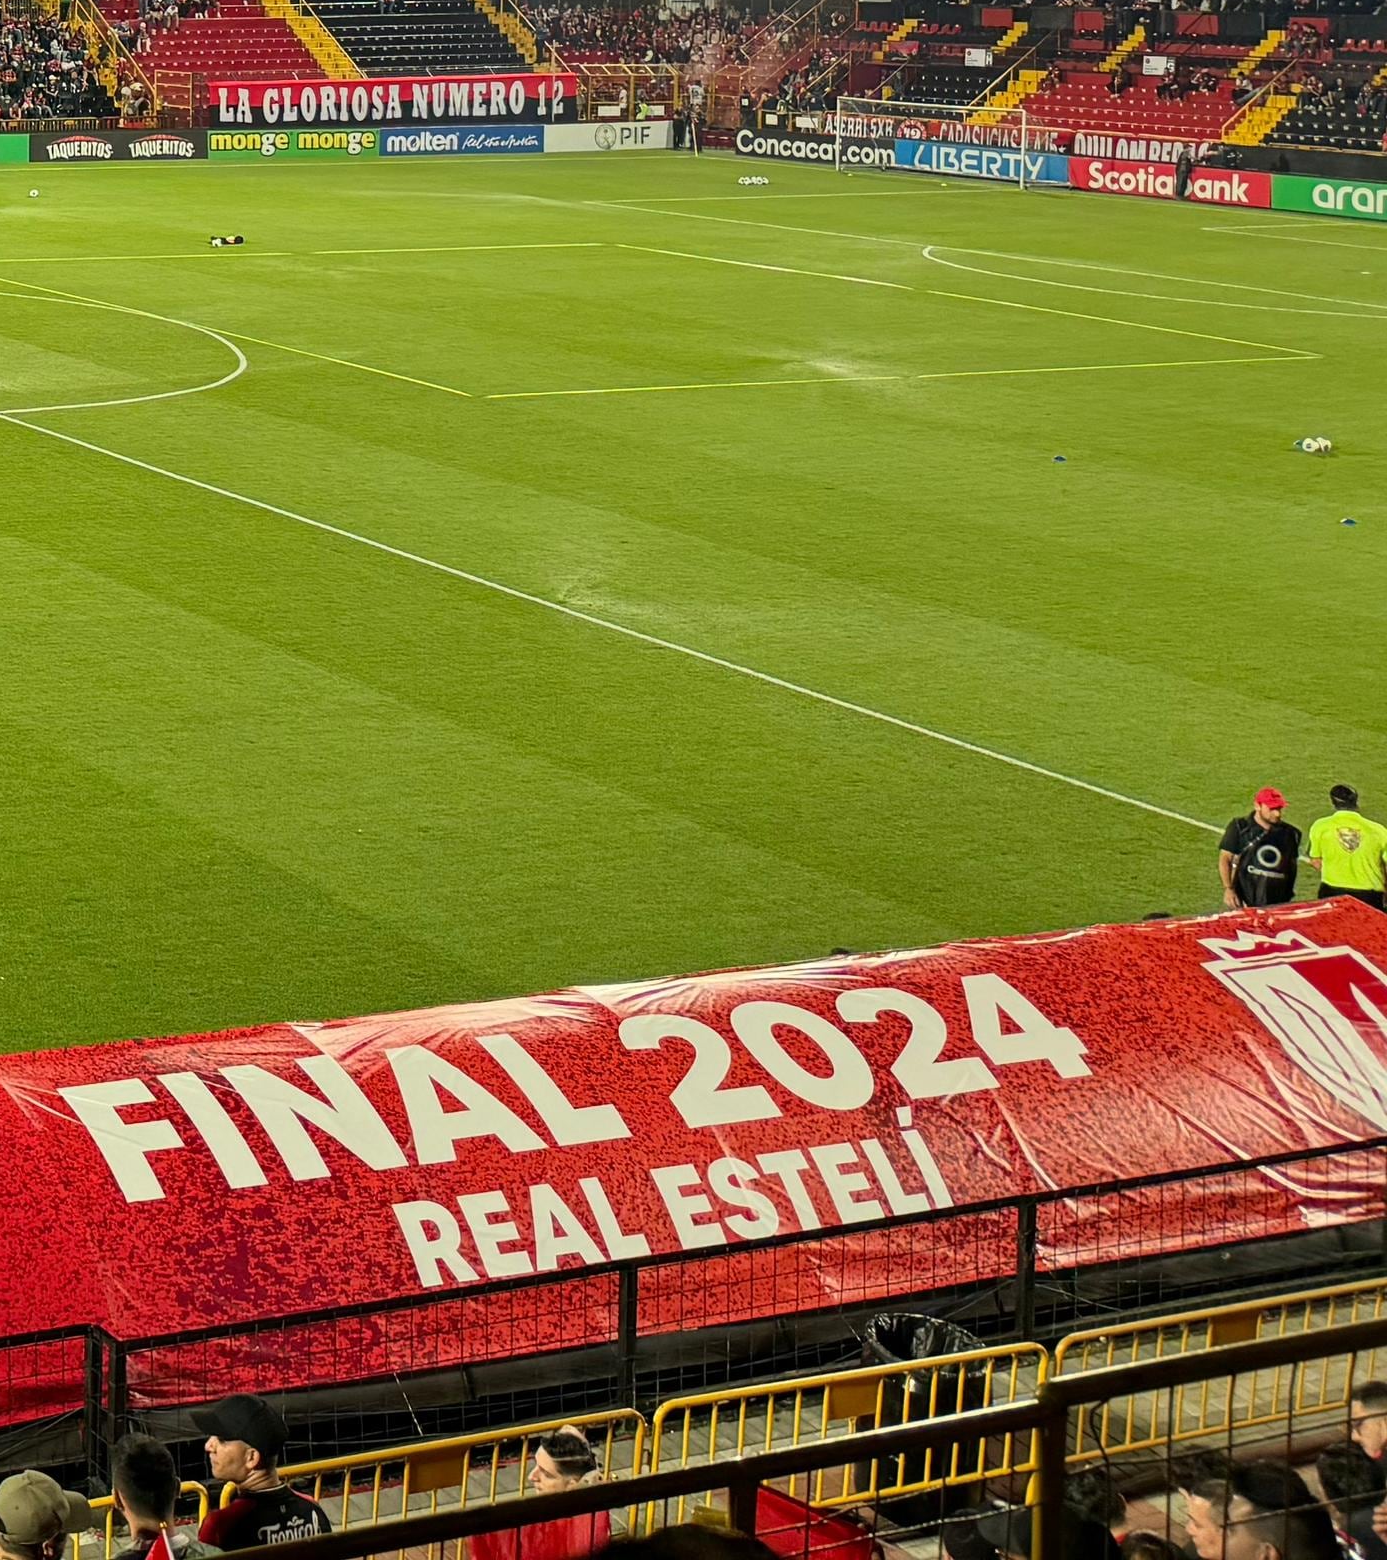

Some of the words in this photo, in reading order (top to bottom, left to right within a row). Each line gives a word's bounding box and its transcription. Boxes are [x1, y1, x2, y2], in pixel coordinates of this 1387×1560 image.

[218, 87, 253, 124] LA
[262, 83, 401, 124] GLORIOSA
[412, 80, 525, 121] NUMERO
[537, 79, 565, 118] 12
[209, 131, 290, 157] monge
[297, 130, 376, 156] monge
[386, 131, 458, 153] molten
[620, 125, 651, 145] PIF
[45, 143, 114, 161] TAQUERITOS
[128, 141, 196, 159] TAQUERITOS
[914, 144, 1045, 181] LIBERTY
[58, 1034, 633, 1204] FINAL
[617, 972, 1090, 1129] 2024
[390, 1176, 652, 1288] REAL
[649, 1105, 954, 1246] ESTELÍ
